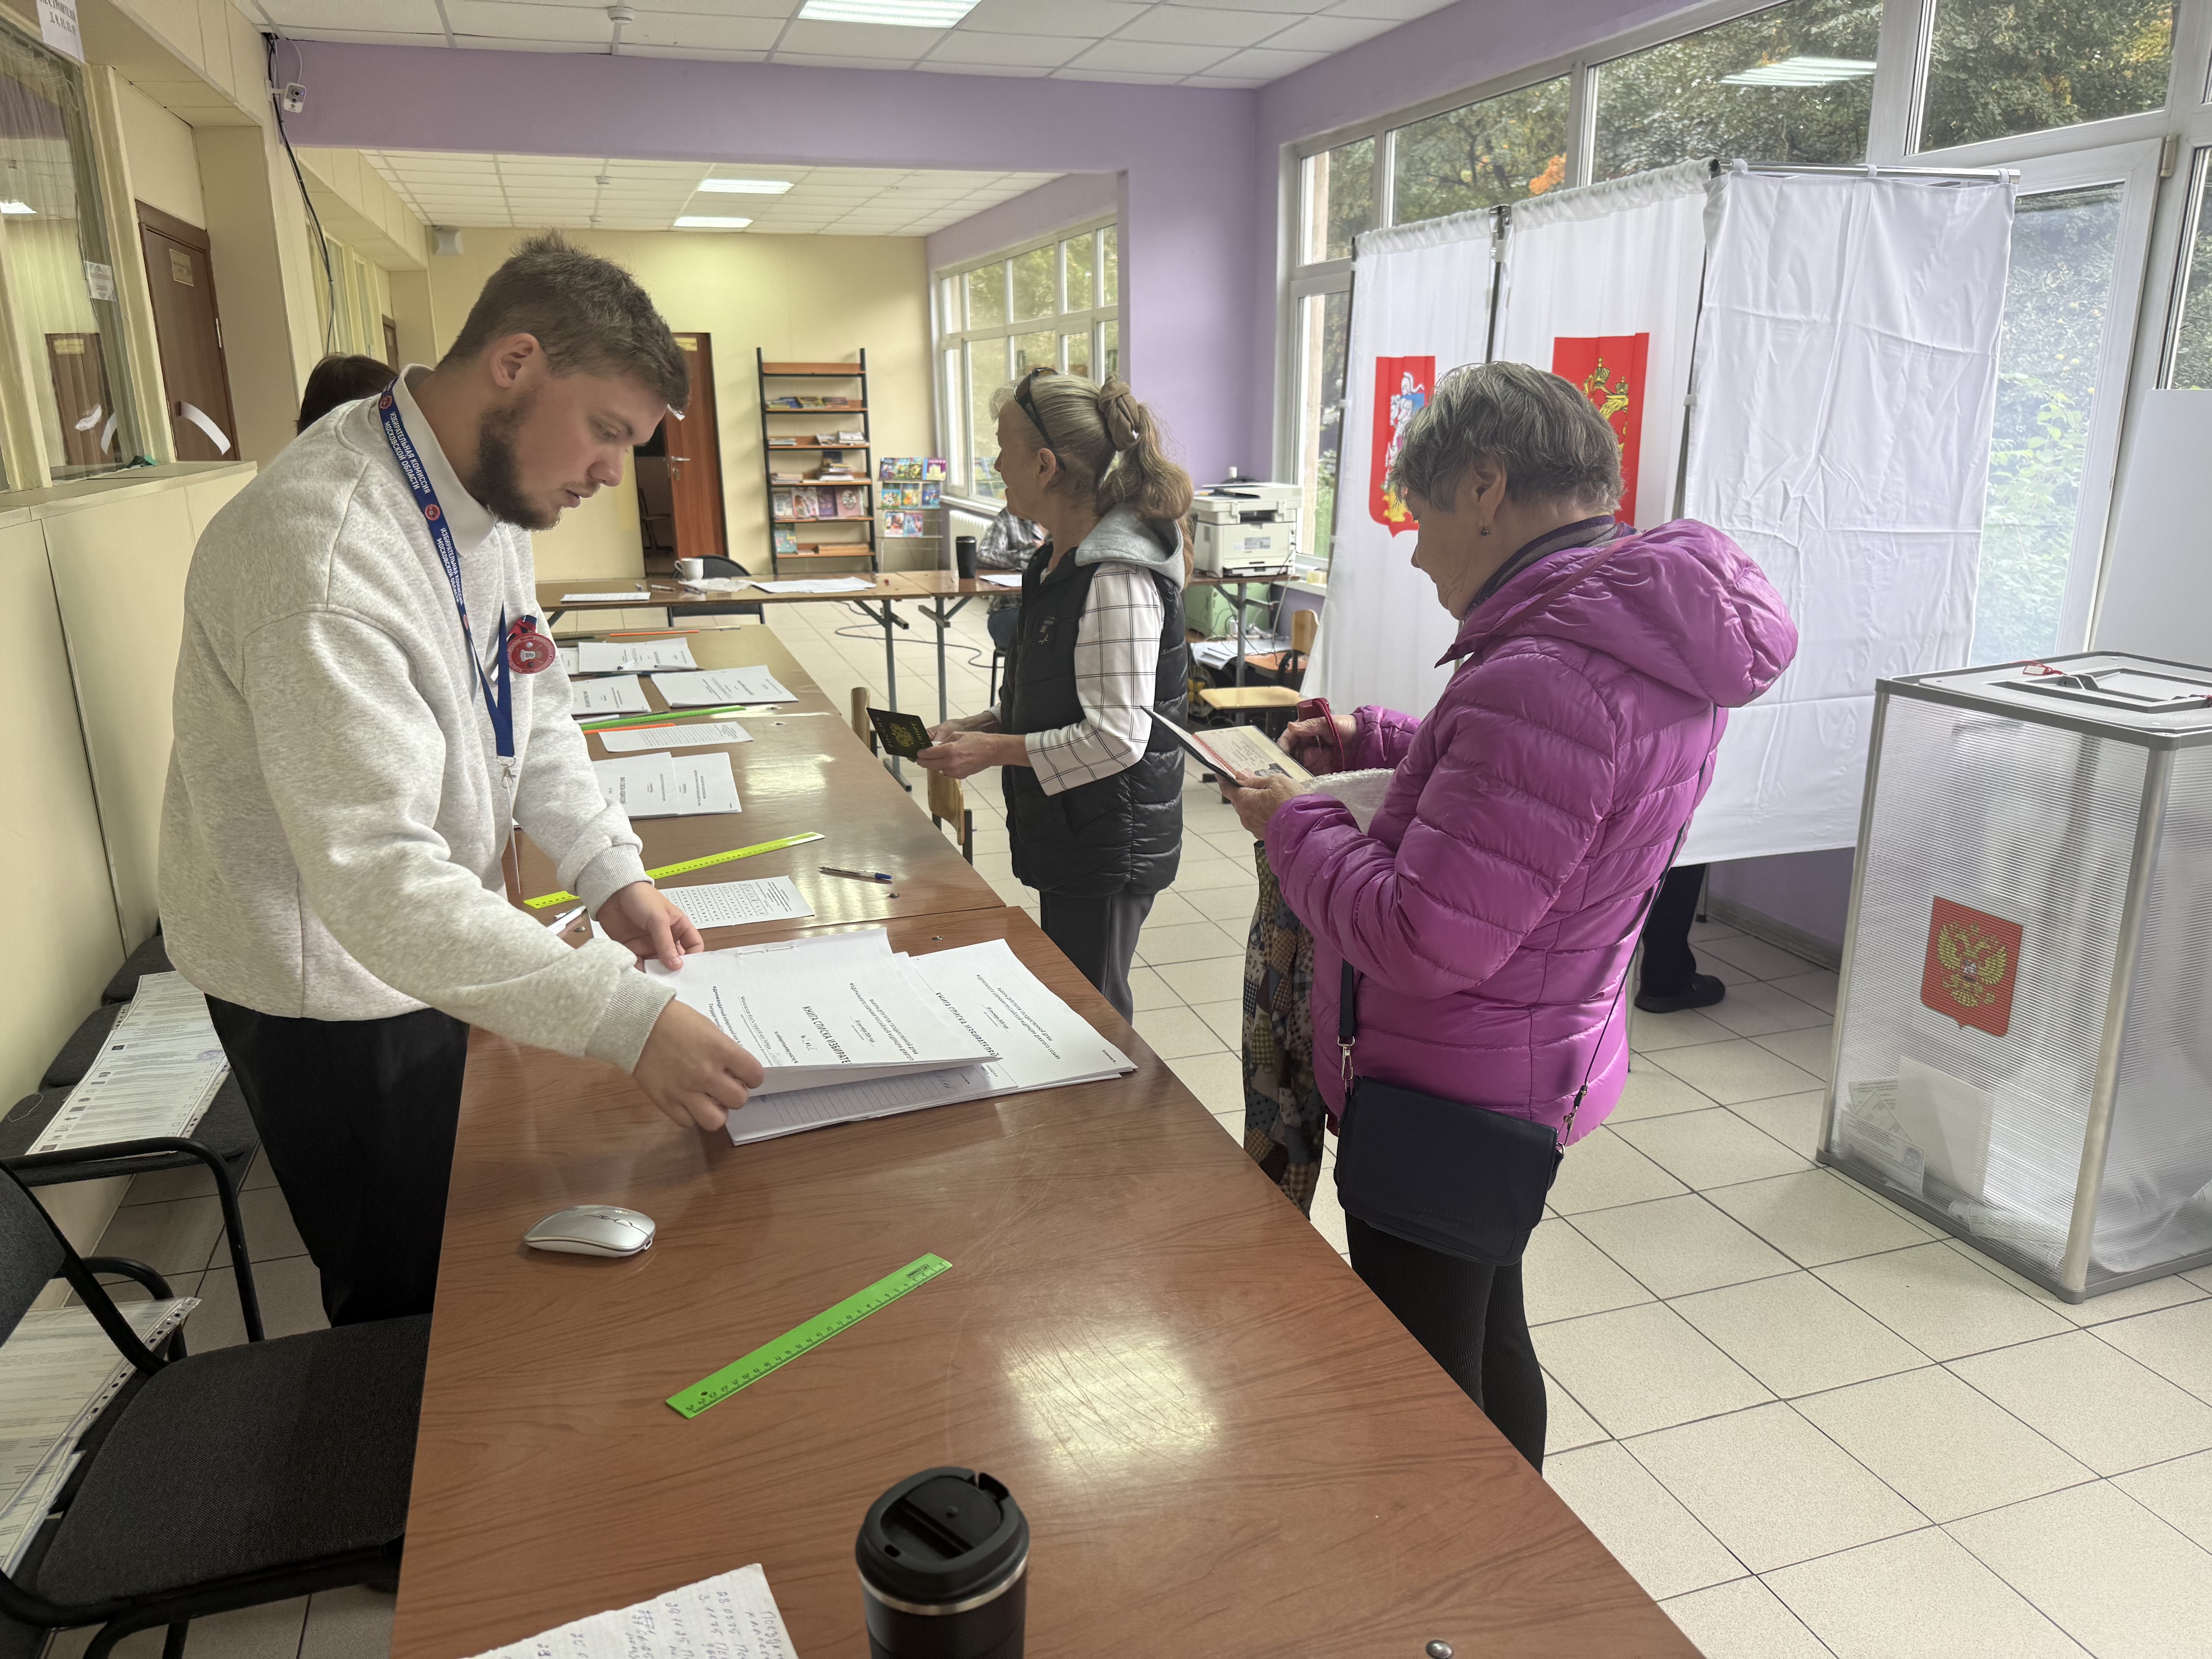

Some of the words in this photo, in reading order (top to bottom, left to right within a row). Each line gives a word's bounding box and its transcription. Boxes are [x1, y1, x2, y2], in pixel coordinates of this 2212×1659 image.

[384, 421, 406, 460] МОСКОВСКОЙ
[401, 460, 420, 490] ОБЛАСТИ
[390, 412, 414, 459] ИЗБИРАТЕЛЬНАЯ
[410, 459, 431, 494] КОМИССИЯ
[436, 538, 454, 578] МОСКОВСКОЙ
[450, 577, 459, 603] ОБЛАСТИ
[440, 527, 458, 575] ИЗБИРАТЕЛЬНАЯ
[802, 1006, 819, 1021] КНИГА
[813, 1021, 833, 1039] СПИСКА
